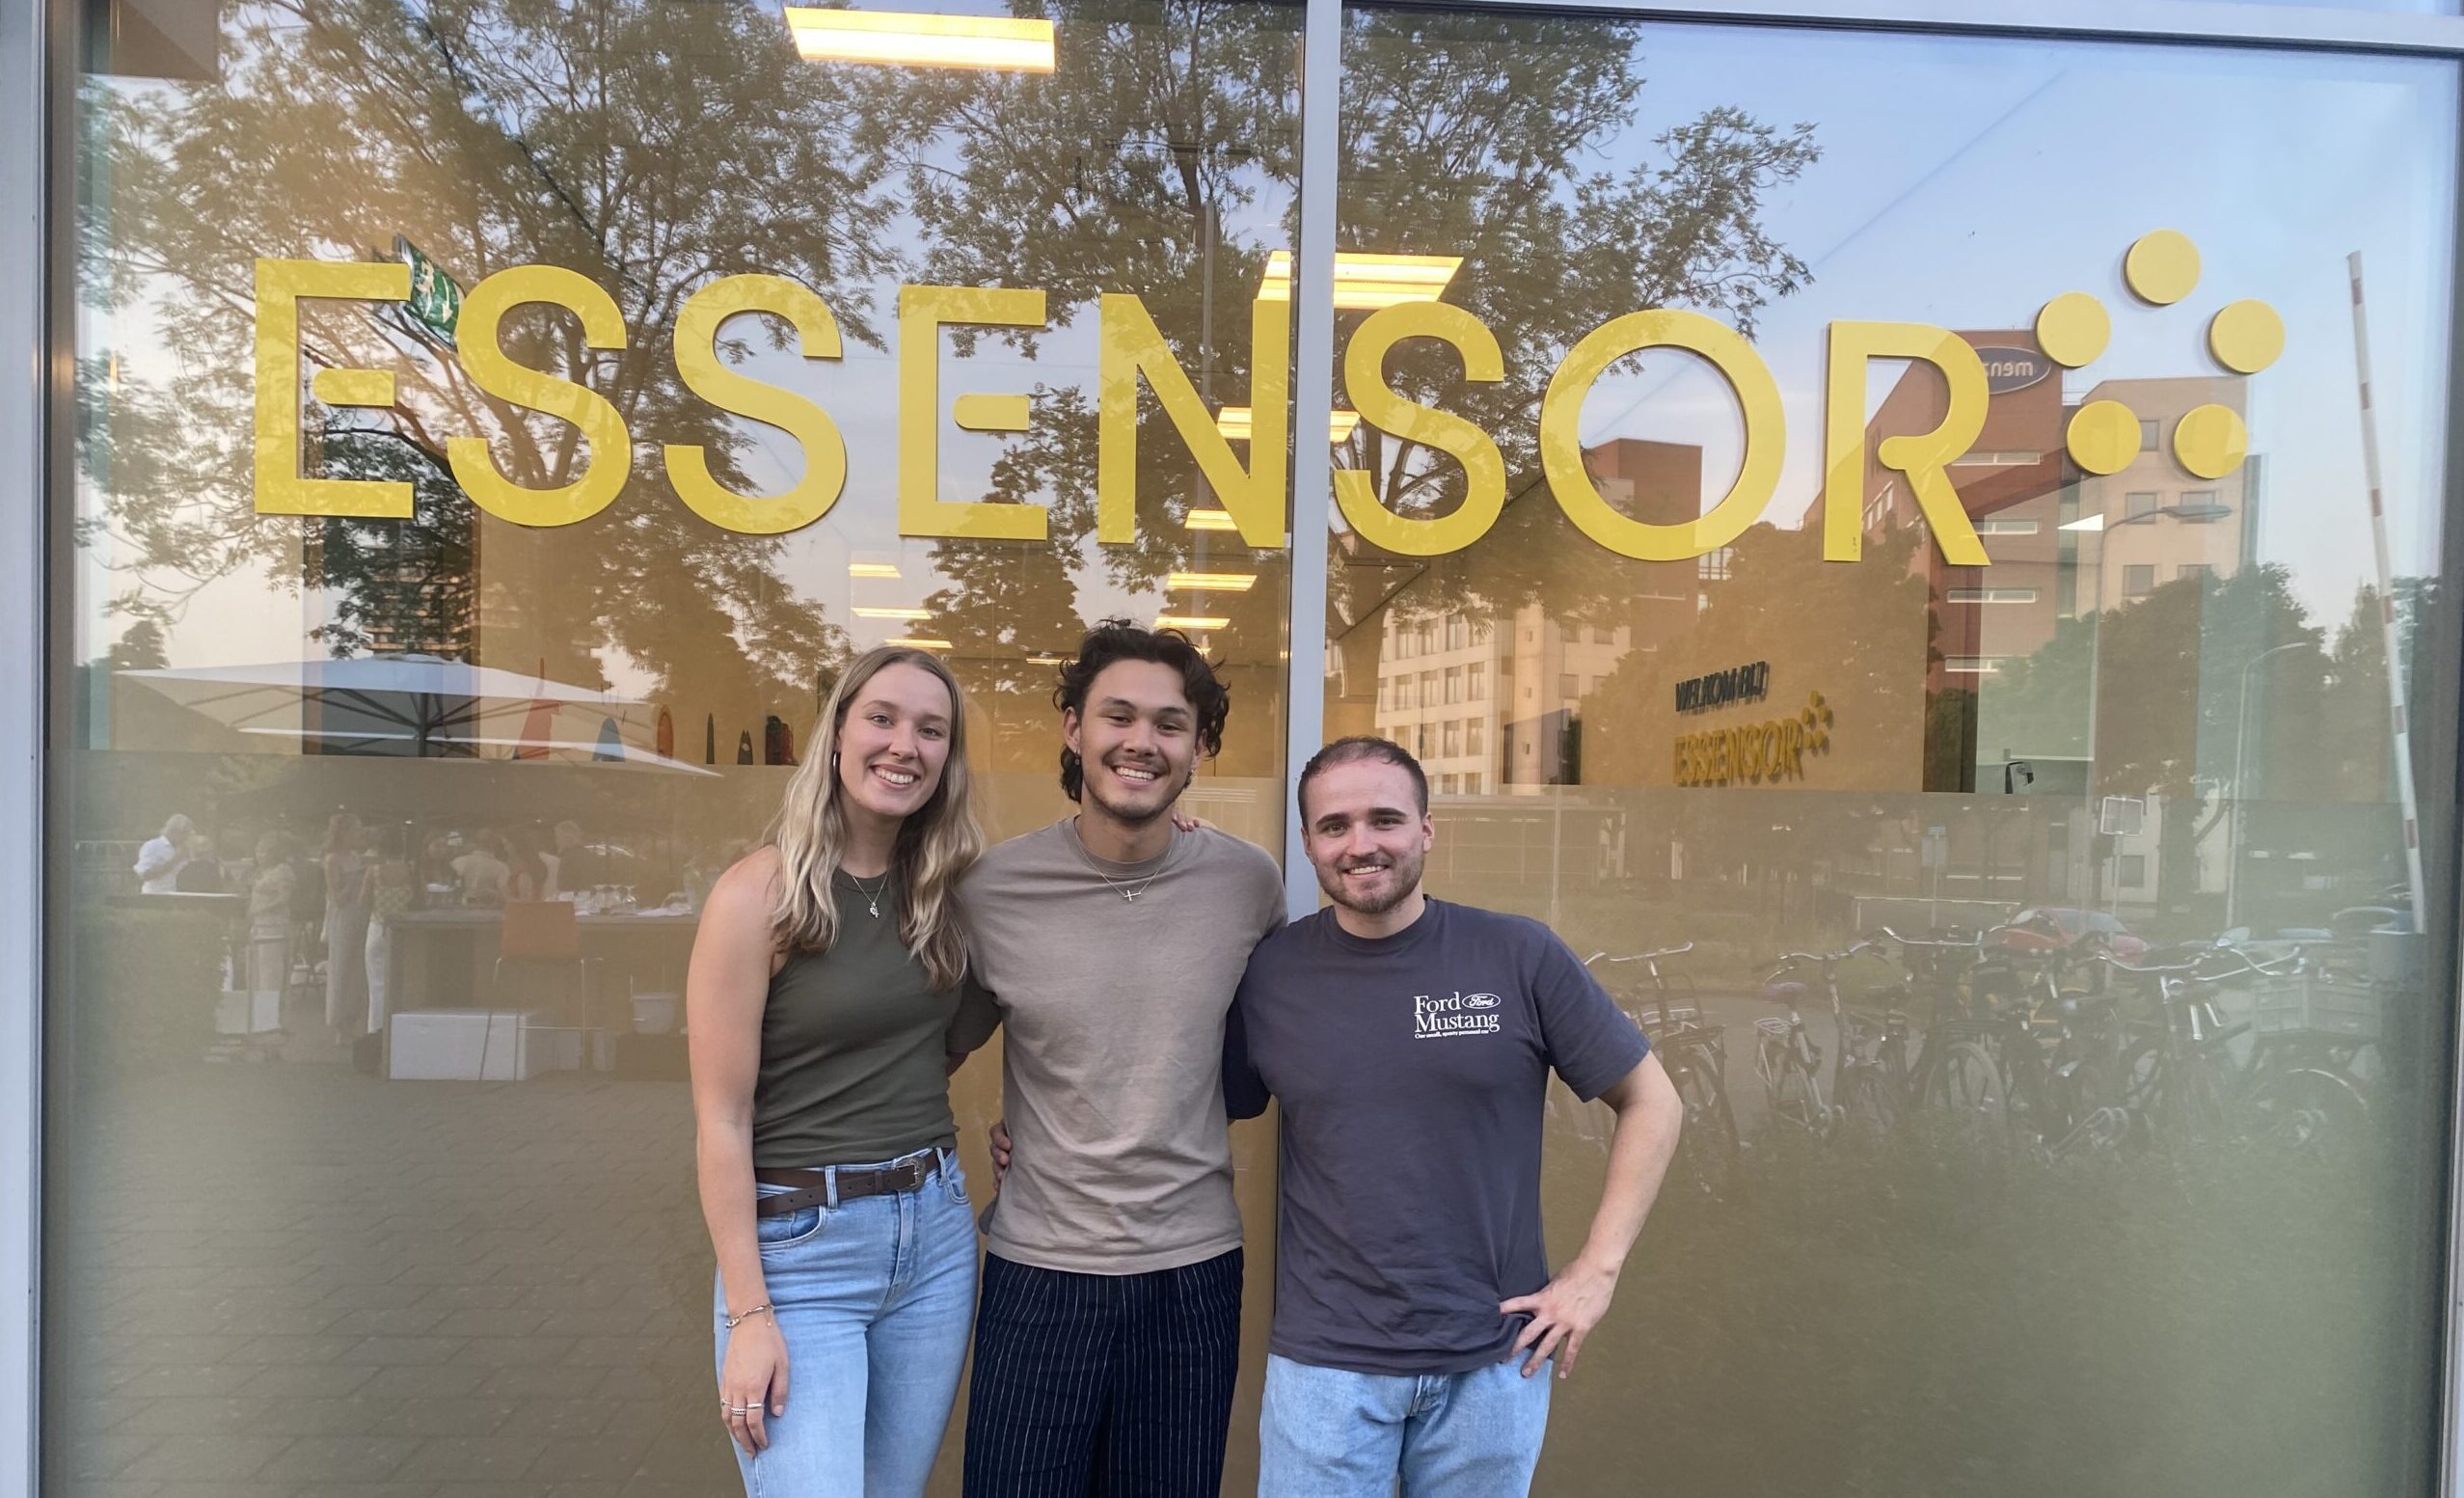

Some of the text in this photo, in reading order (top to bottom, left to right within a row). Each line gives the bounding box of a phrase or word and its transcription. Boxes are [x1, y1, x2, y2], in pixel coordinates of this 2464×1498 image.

[254, 259, 1991, 566] ESSENSOR
[1675, 661, 1767, 712] WELKOM BIJ
[1673, 719, 1802, 783] ESSENSOR
[1413, 992, 1462, 1014] Ford
[1414, 1012, 1501, 1033] Mustang
